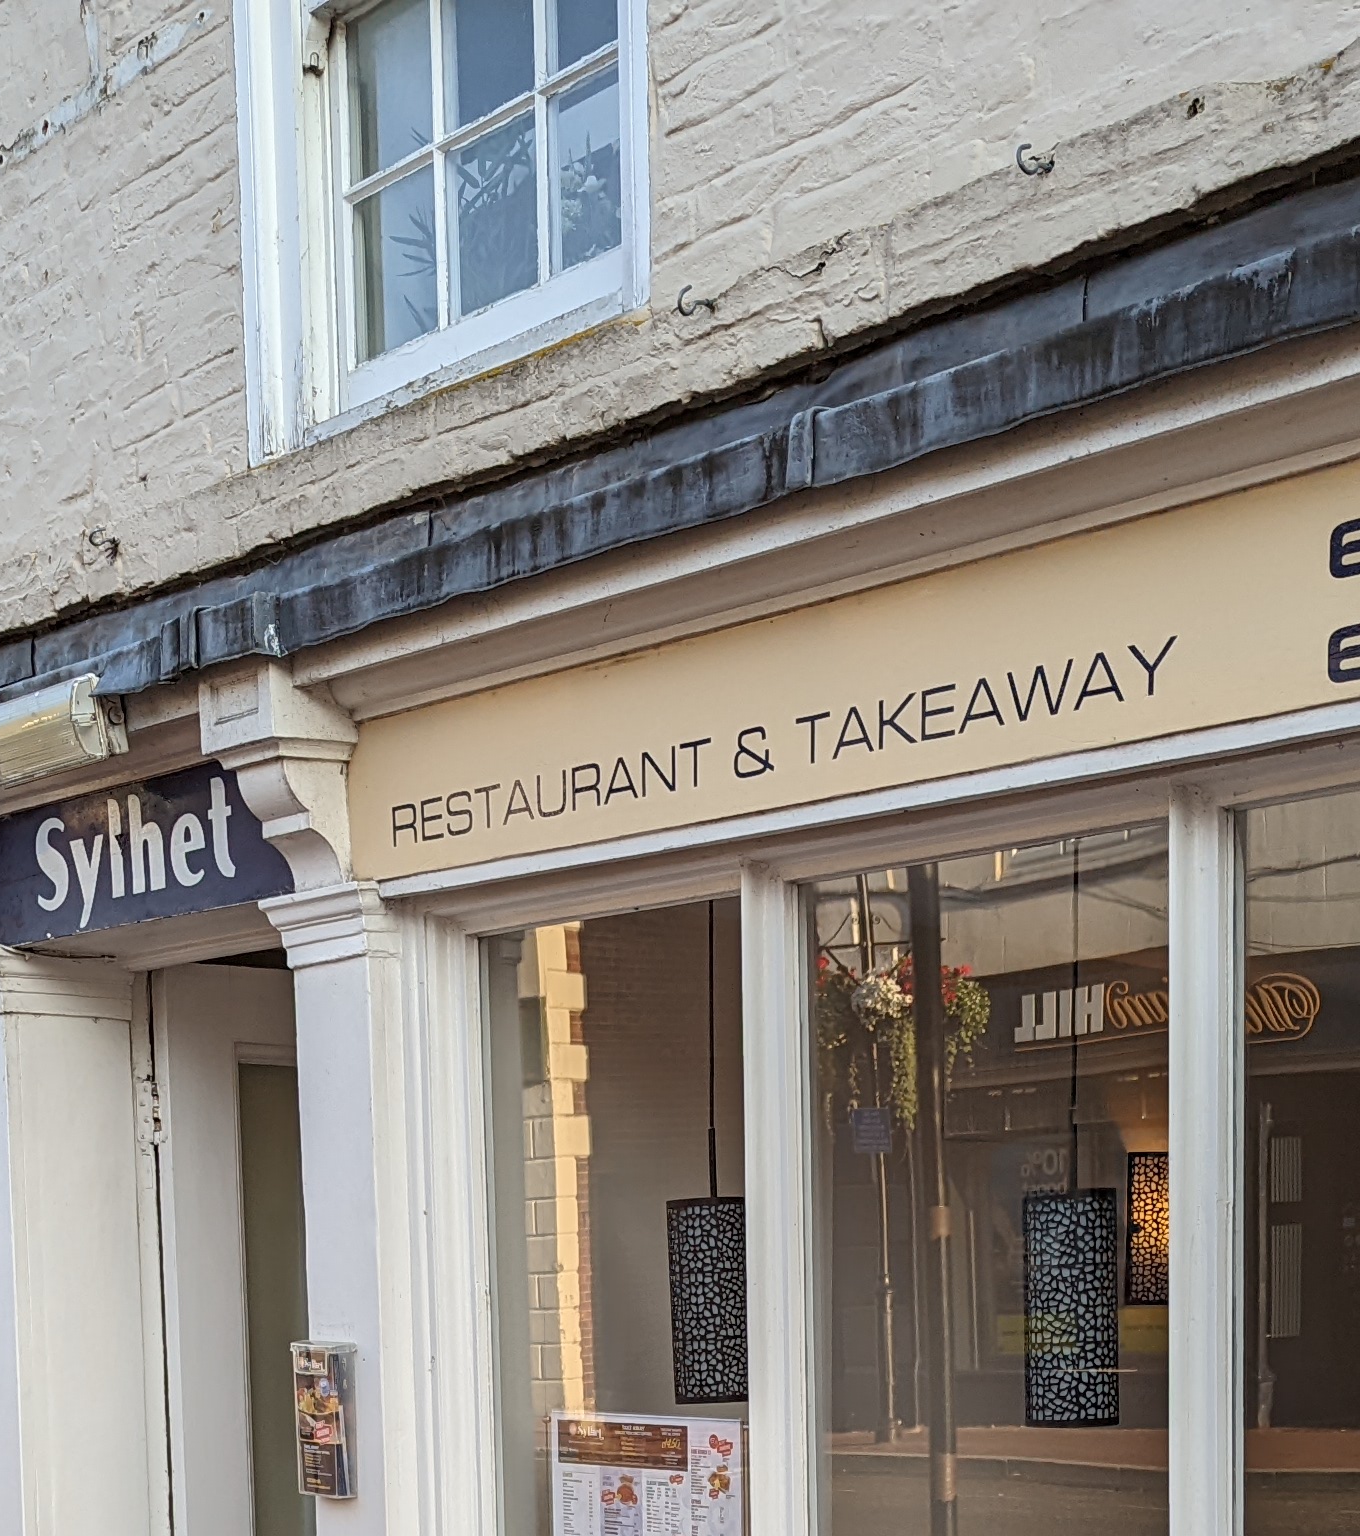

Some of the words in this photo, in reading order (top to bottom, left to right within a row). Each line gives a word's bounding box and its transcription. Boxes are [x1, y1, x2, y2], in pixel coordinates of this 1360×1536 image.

[392, 737, 712, 848] RESTAURANT
[732, 725, 775, 780] &
[795, 635, 1179, 766] TAKEAWAY
[36, 776, 237, 928] Sylhet
